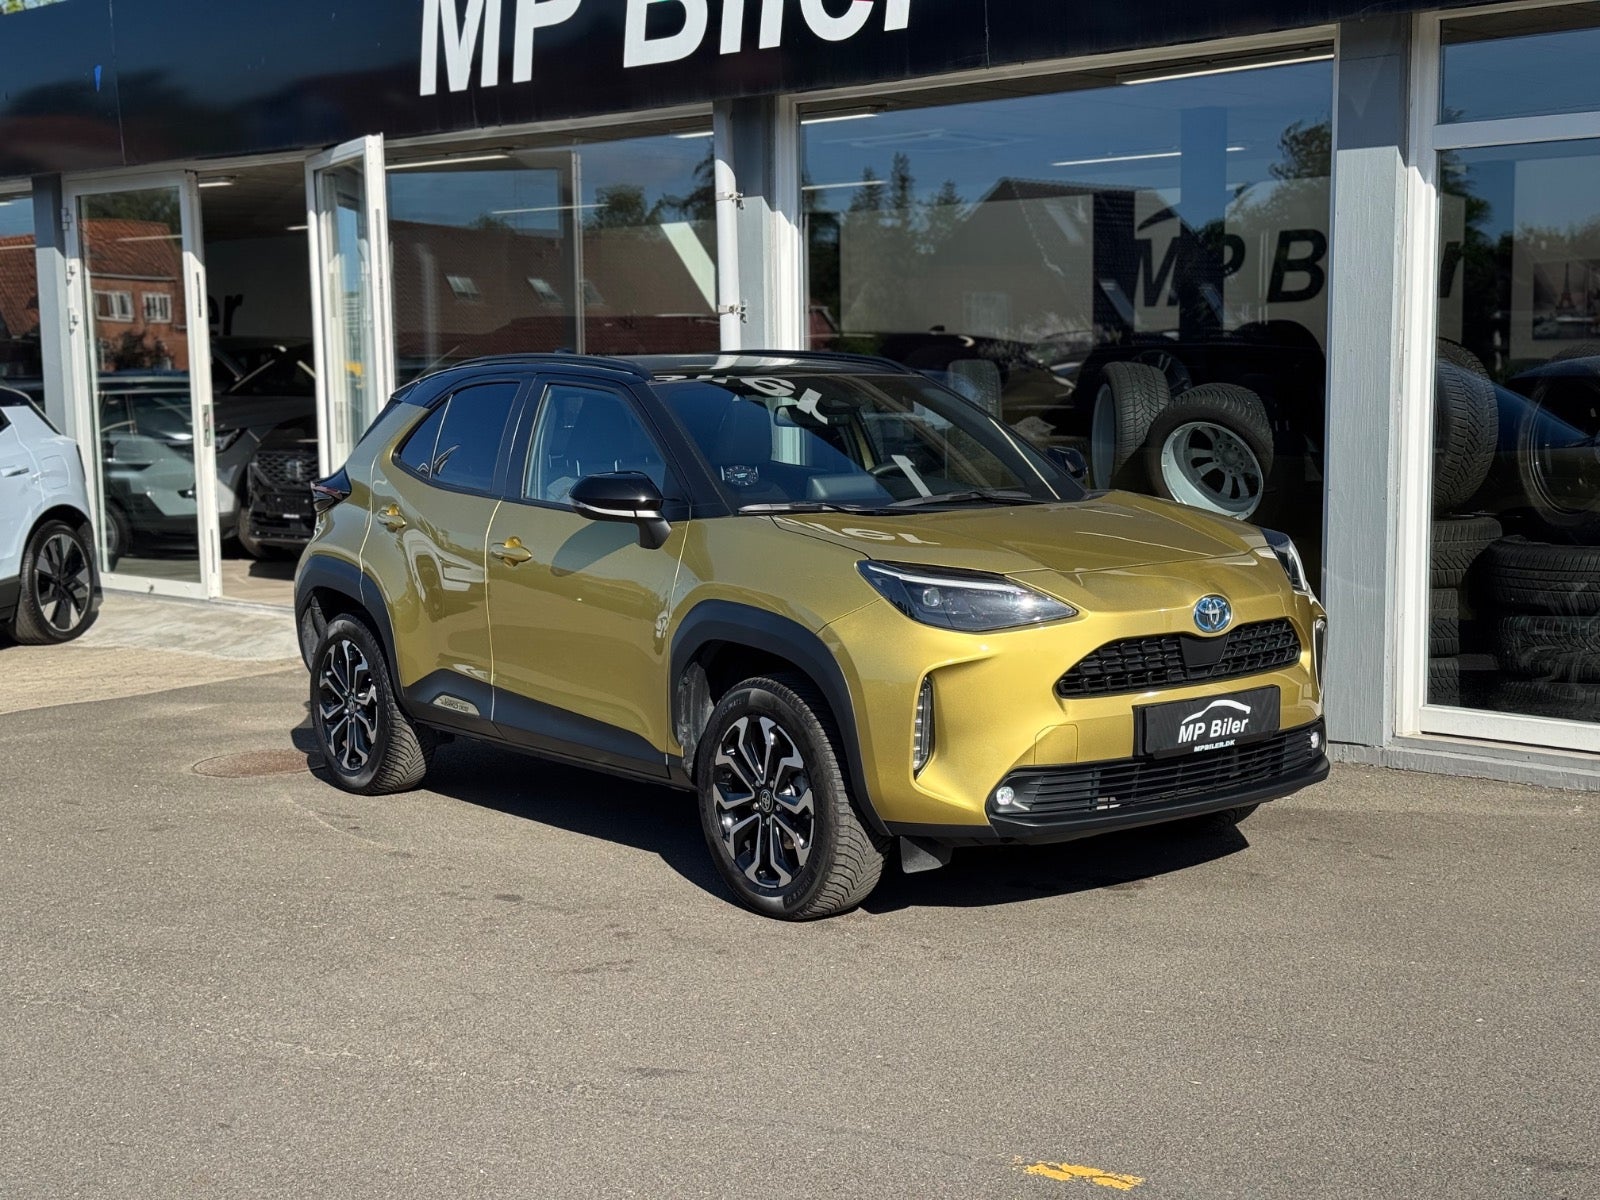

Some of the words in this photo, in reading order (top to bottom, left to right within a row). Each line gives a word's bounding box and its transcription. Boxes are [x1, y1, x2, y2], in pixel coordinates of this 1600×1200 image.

[419, 0, 582, 96] MP
[1177, 722, 1206, 744] MP
[1209, 717, 1249, 738] Biler
[1193, 739, 1236, 752] MPBILER.DK
